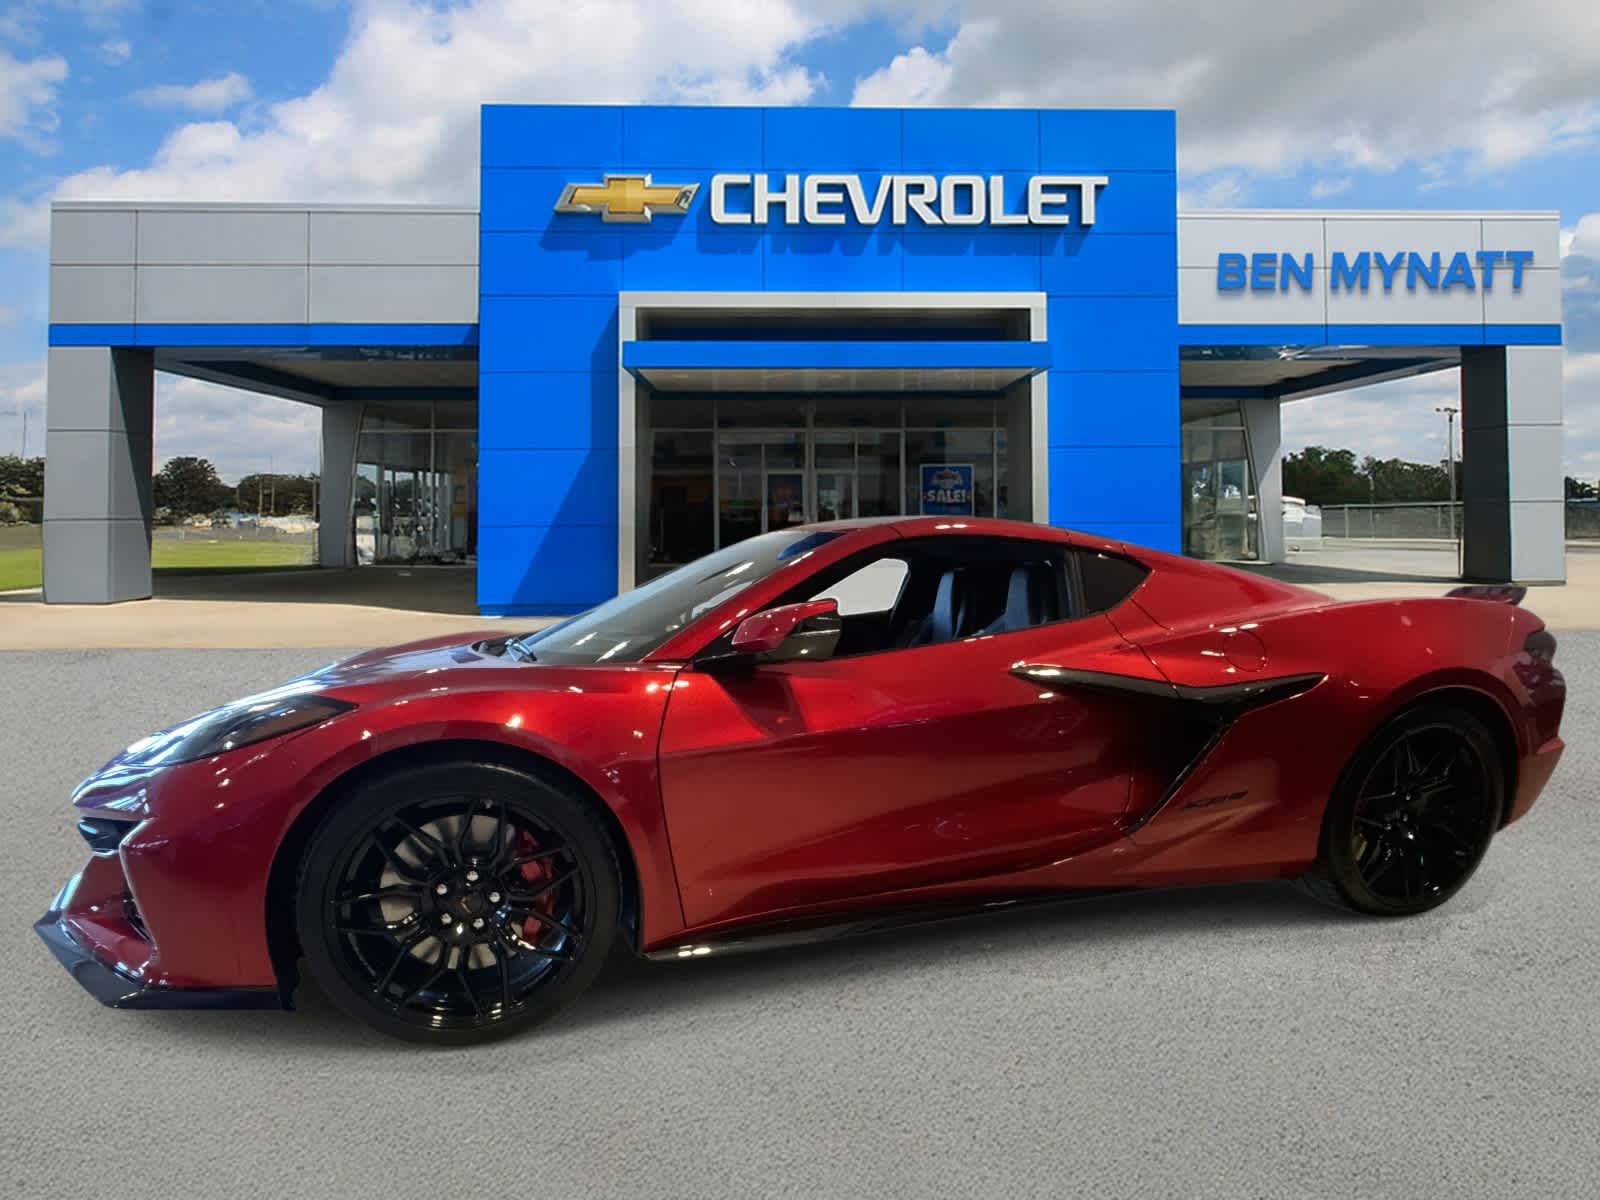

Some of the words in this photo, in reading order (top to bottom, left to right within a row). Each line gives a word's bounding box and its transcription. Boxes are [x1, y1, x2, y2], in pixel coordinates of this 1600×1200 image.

[711, 174, 1109, 226] CHEVROLET
[1217, 252, 1314, 291] BEN
[1330, 250, 1534, 292] MYNATT
